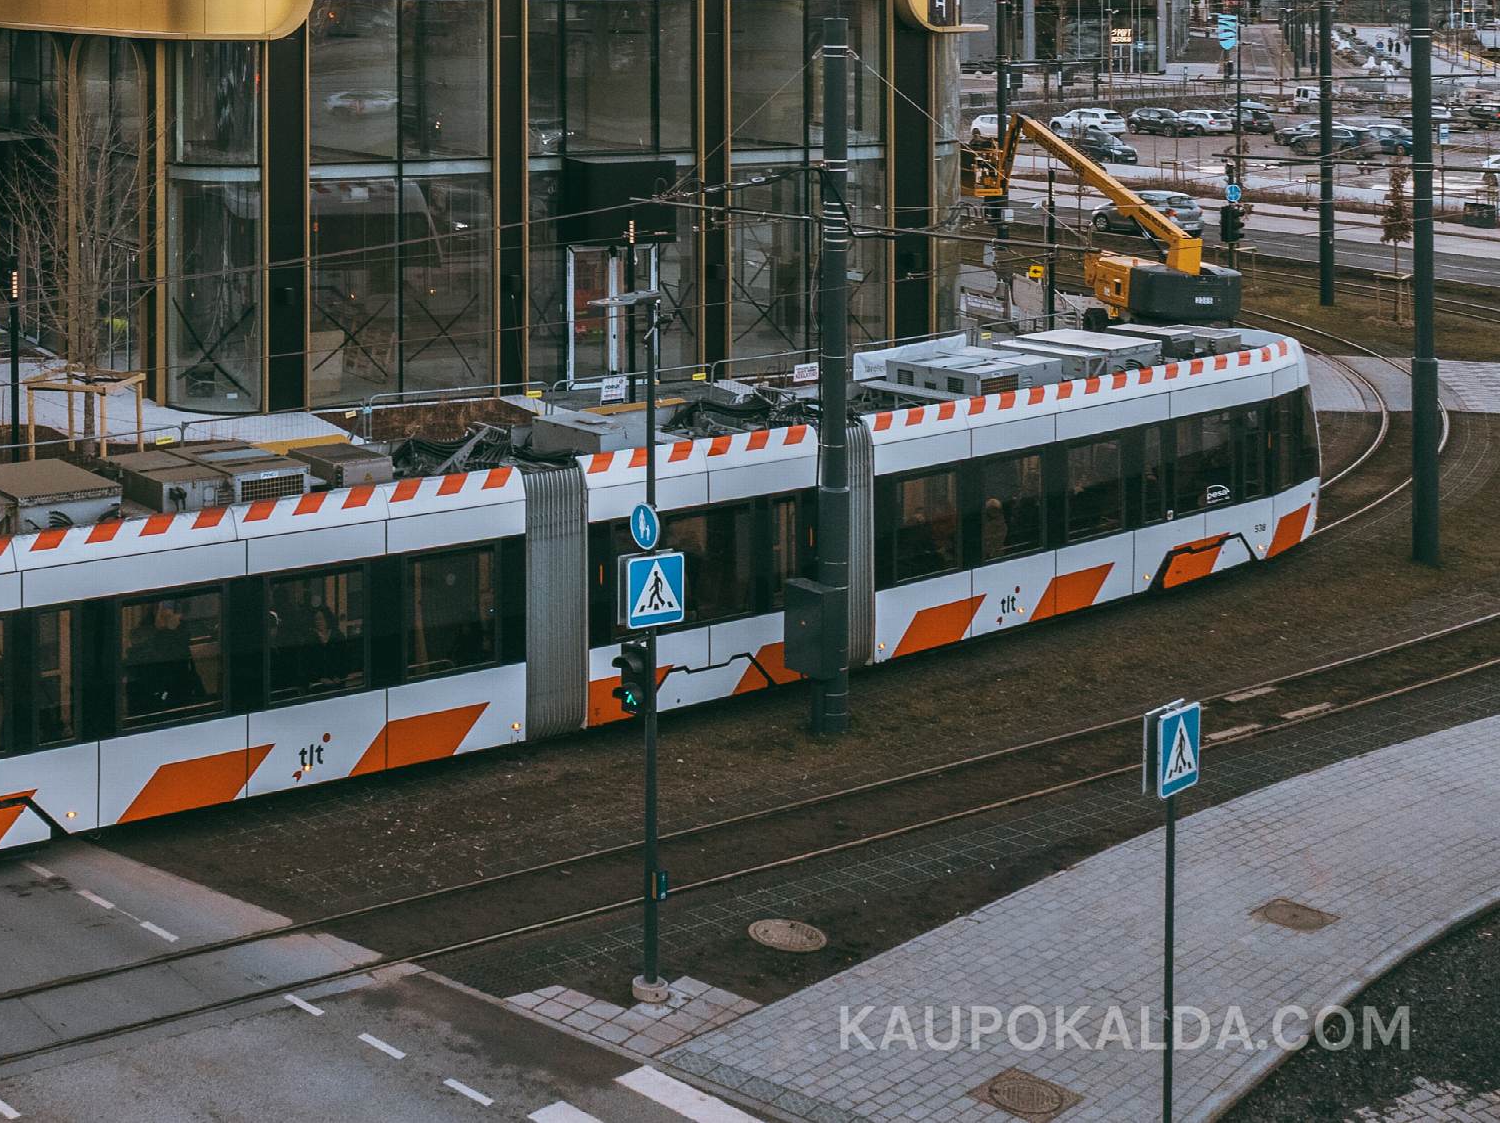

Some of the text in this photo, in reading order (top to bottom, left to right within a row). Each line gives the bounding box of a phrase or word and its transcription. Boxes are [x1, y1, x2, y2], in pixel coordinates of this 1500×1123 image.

[1206, 488, 1229, 500] pesa
[1254, 523, 1267, 533] 538
[1000, 595, 1016, 615] tlt
[298, 743, 324, 767] tlt
